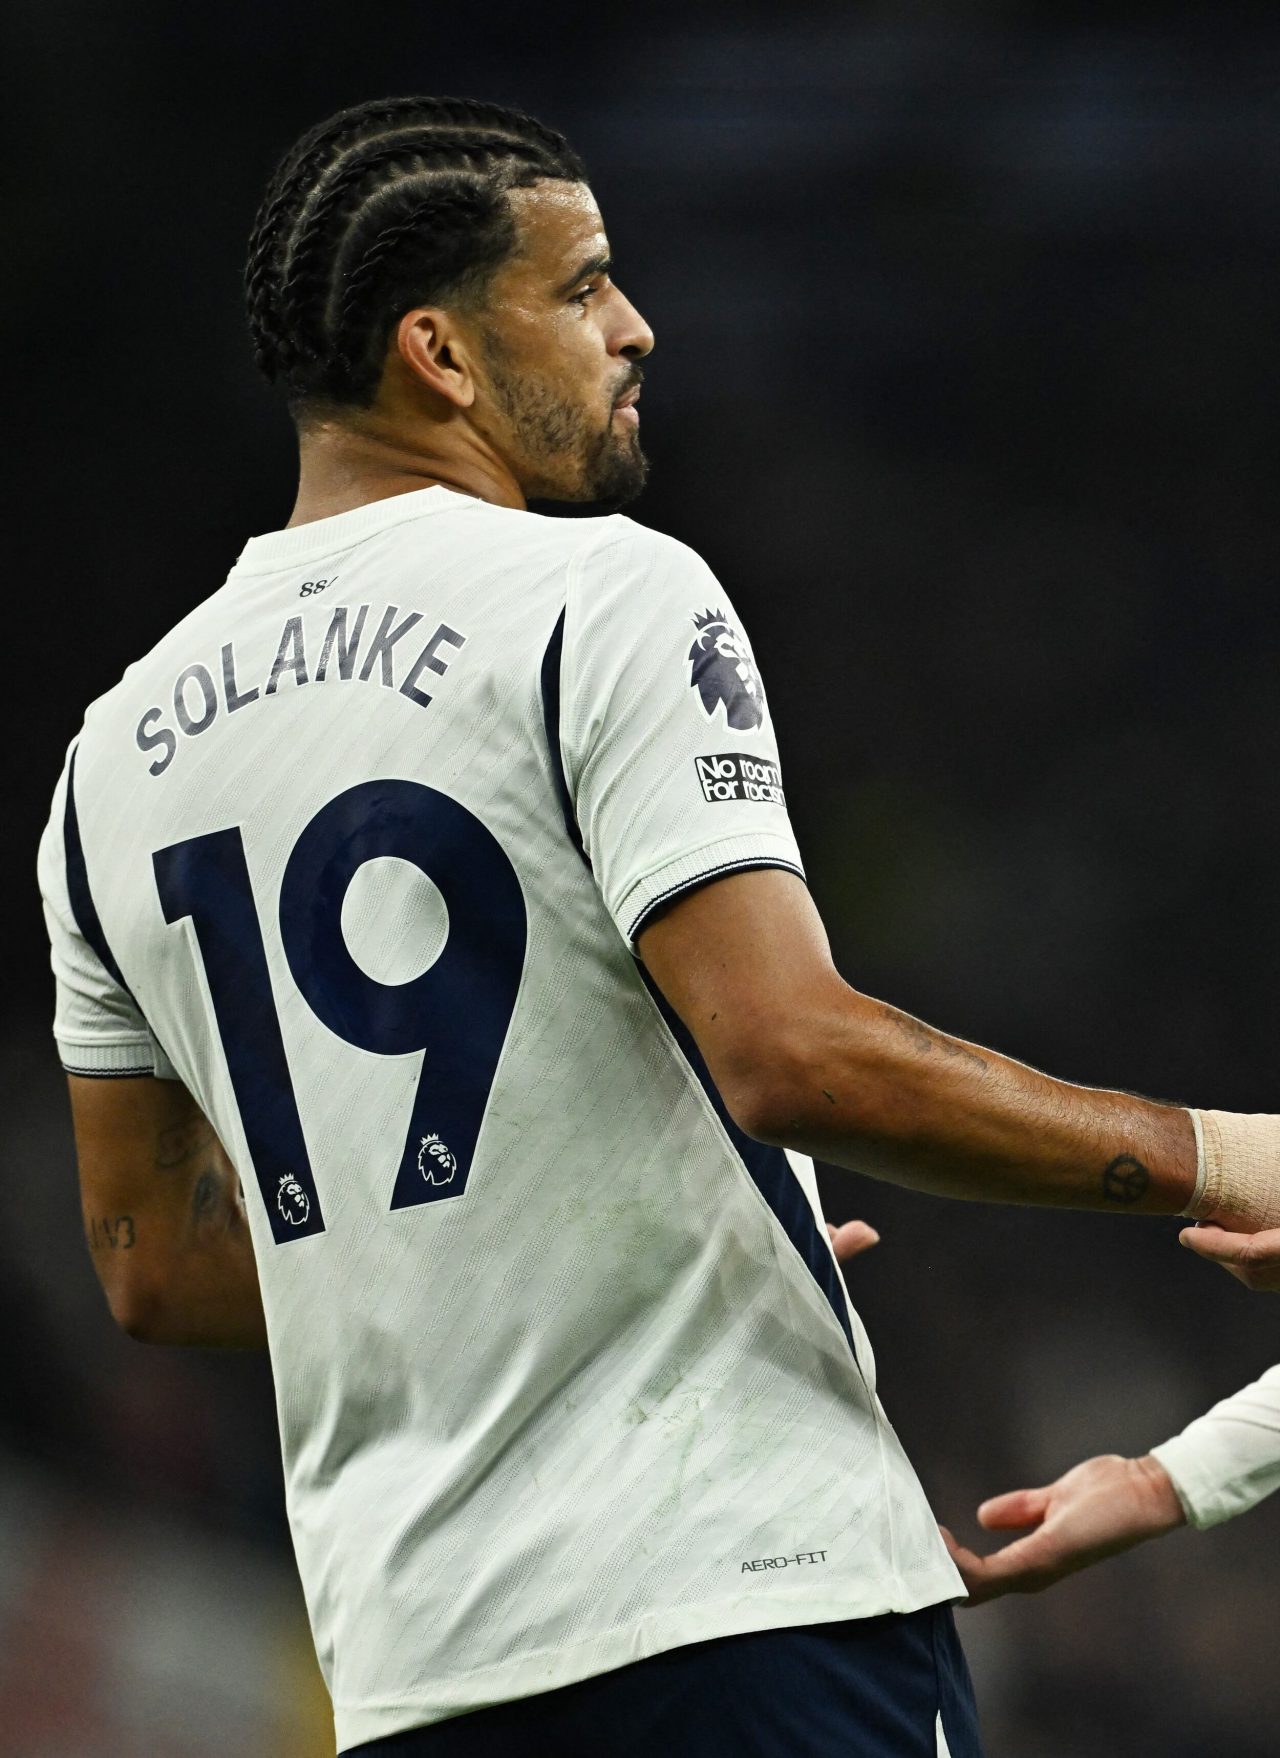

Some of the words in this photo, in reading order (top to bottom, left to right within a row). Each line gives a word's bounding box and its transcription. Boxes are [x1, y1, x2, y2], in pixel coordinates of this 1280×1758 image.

[135, 604, 467, 776] SOLANKE
[696, 756, 736, 781] No
[739, 761, 782, 786] room
[702, 779, 738, 801] for
[152, 778, 528, 1246] 19
[741, 1550, 828, 1573] AERO-FIT
